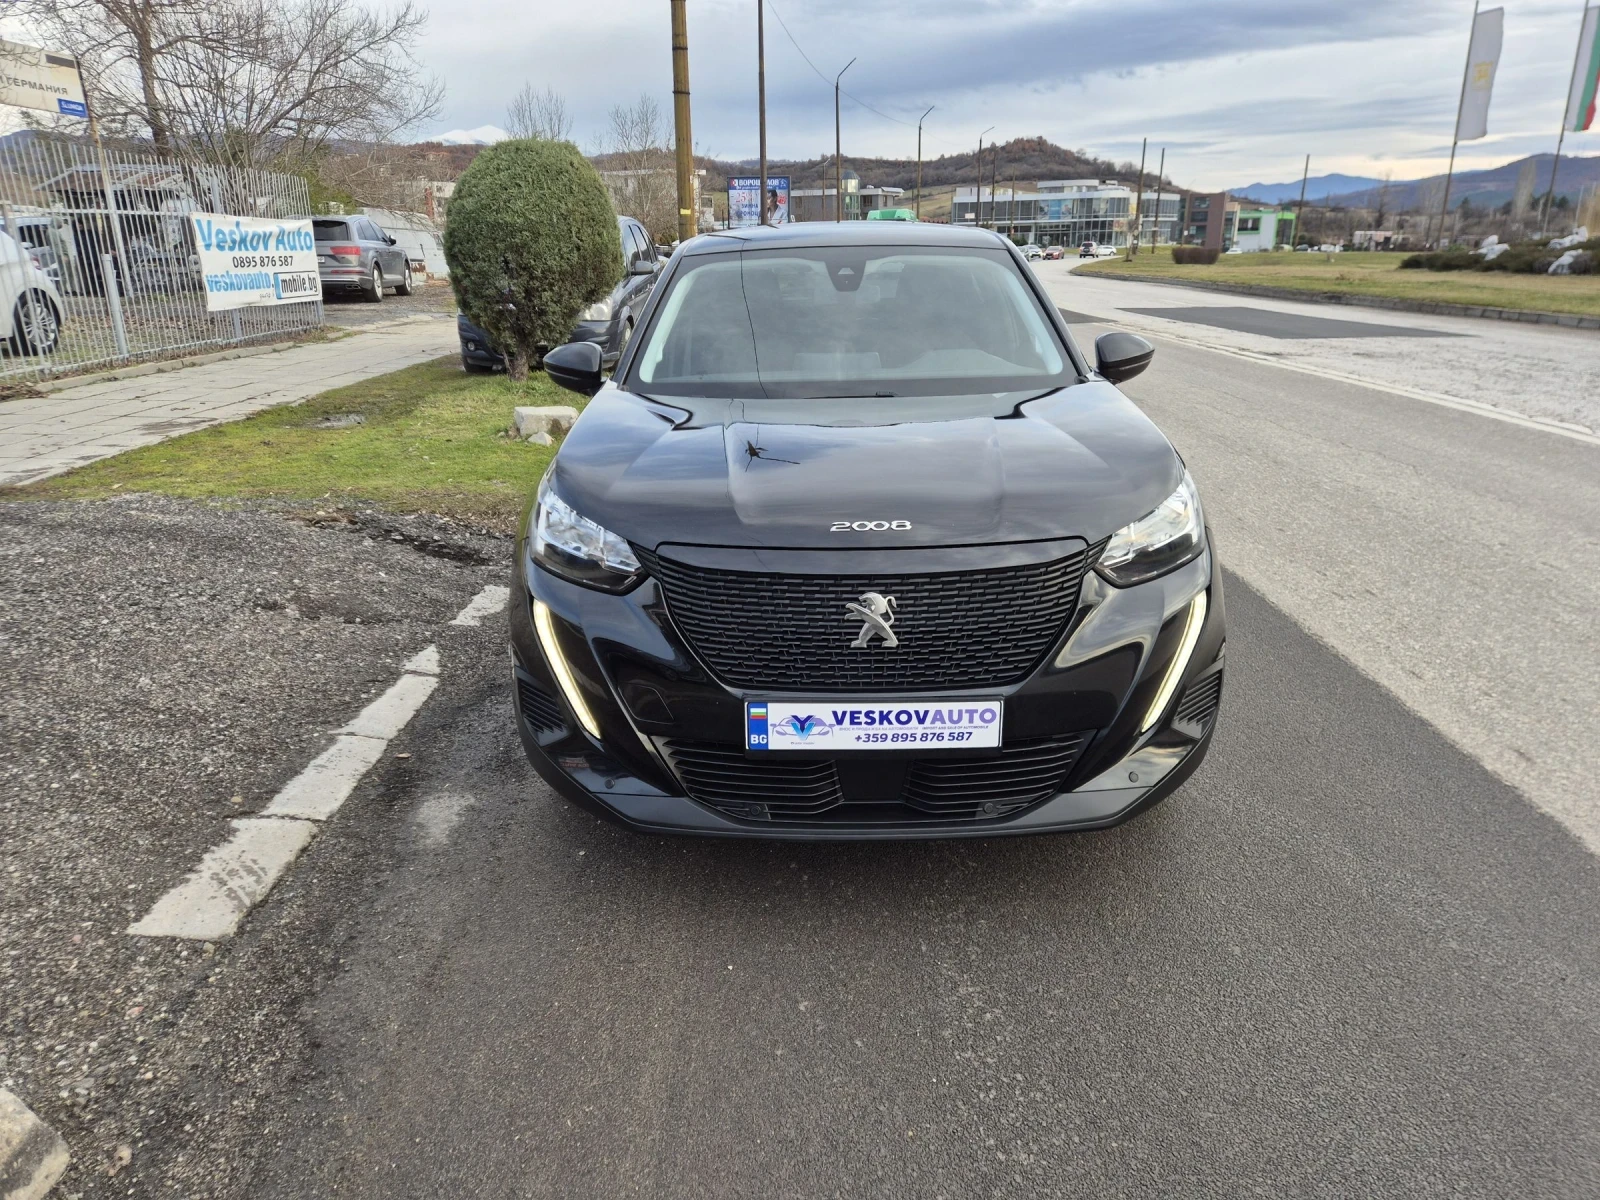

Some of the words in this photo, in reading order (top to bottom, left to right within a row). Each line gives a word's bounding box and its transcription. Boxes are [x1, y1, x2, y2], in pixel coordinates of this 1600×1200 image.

[6, 76, 68, 95] ГЕРМАНИЯ
[195, 219, 273, 252] Veskov
[276, 225, 314, 252] Auto
[232, 256, 258, 269] 0895
[259, 255, 277, 267] 876
[279, 255, 294, 267] 587
[830, 520, 912, 532] 2008
[831, 708, 997, 726] VESKOVAUTO
[750, 734, 767, 744] BG
[854, 733, 888, 743] +359
[891, 732, 917, 743] 895
[919, 732, 945, 742] 876
[947, 731, 973, 741] 587
